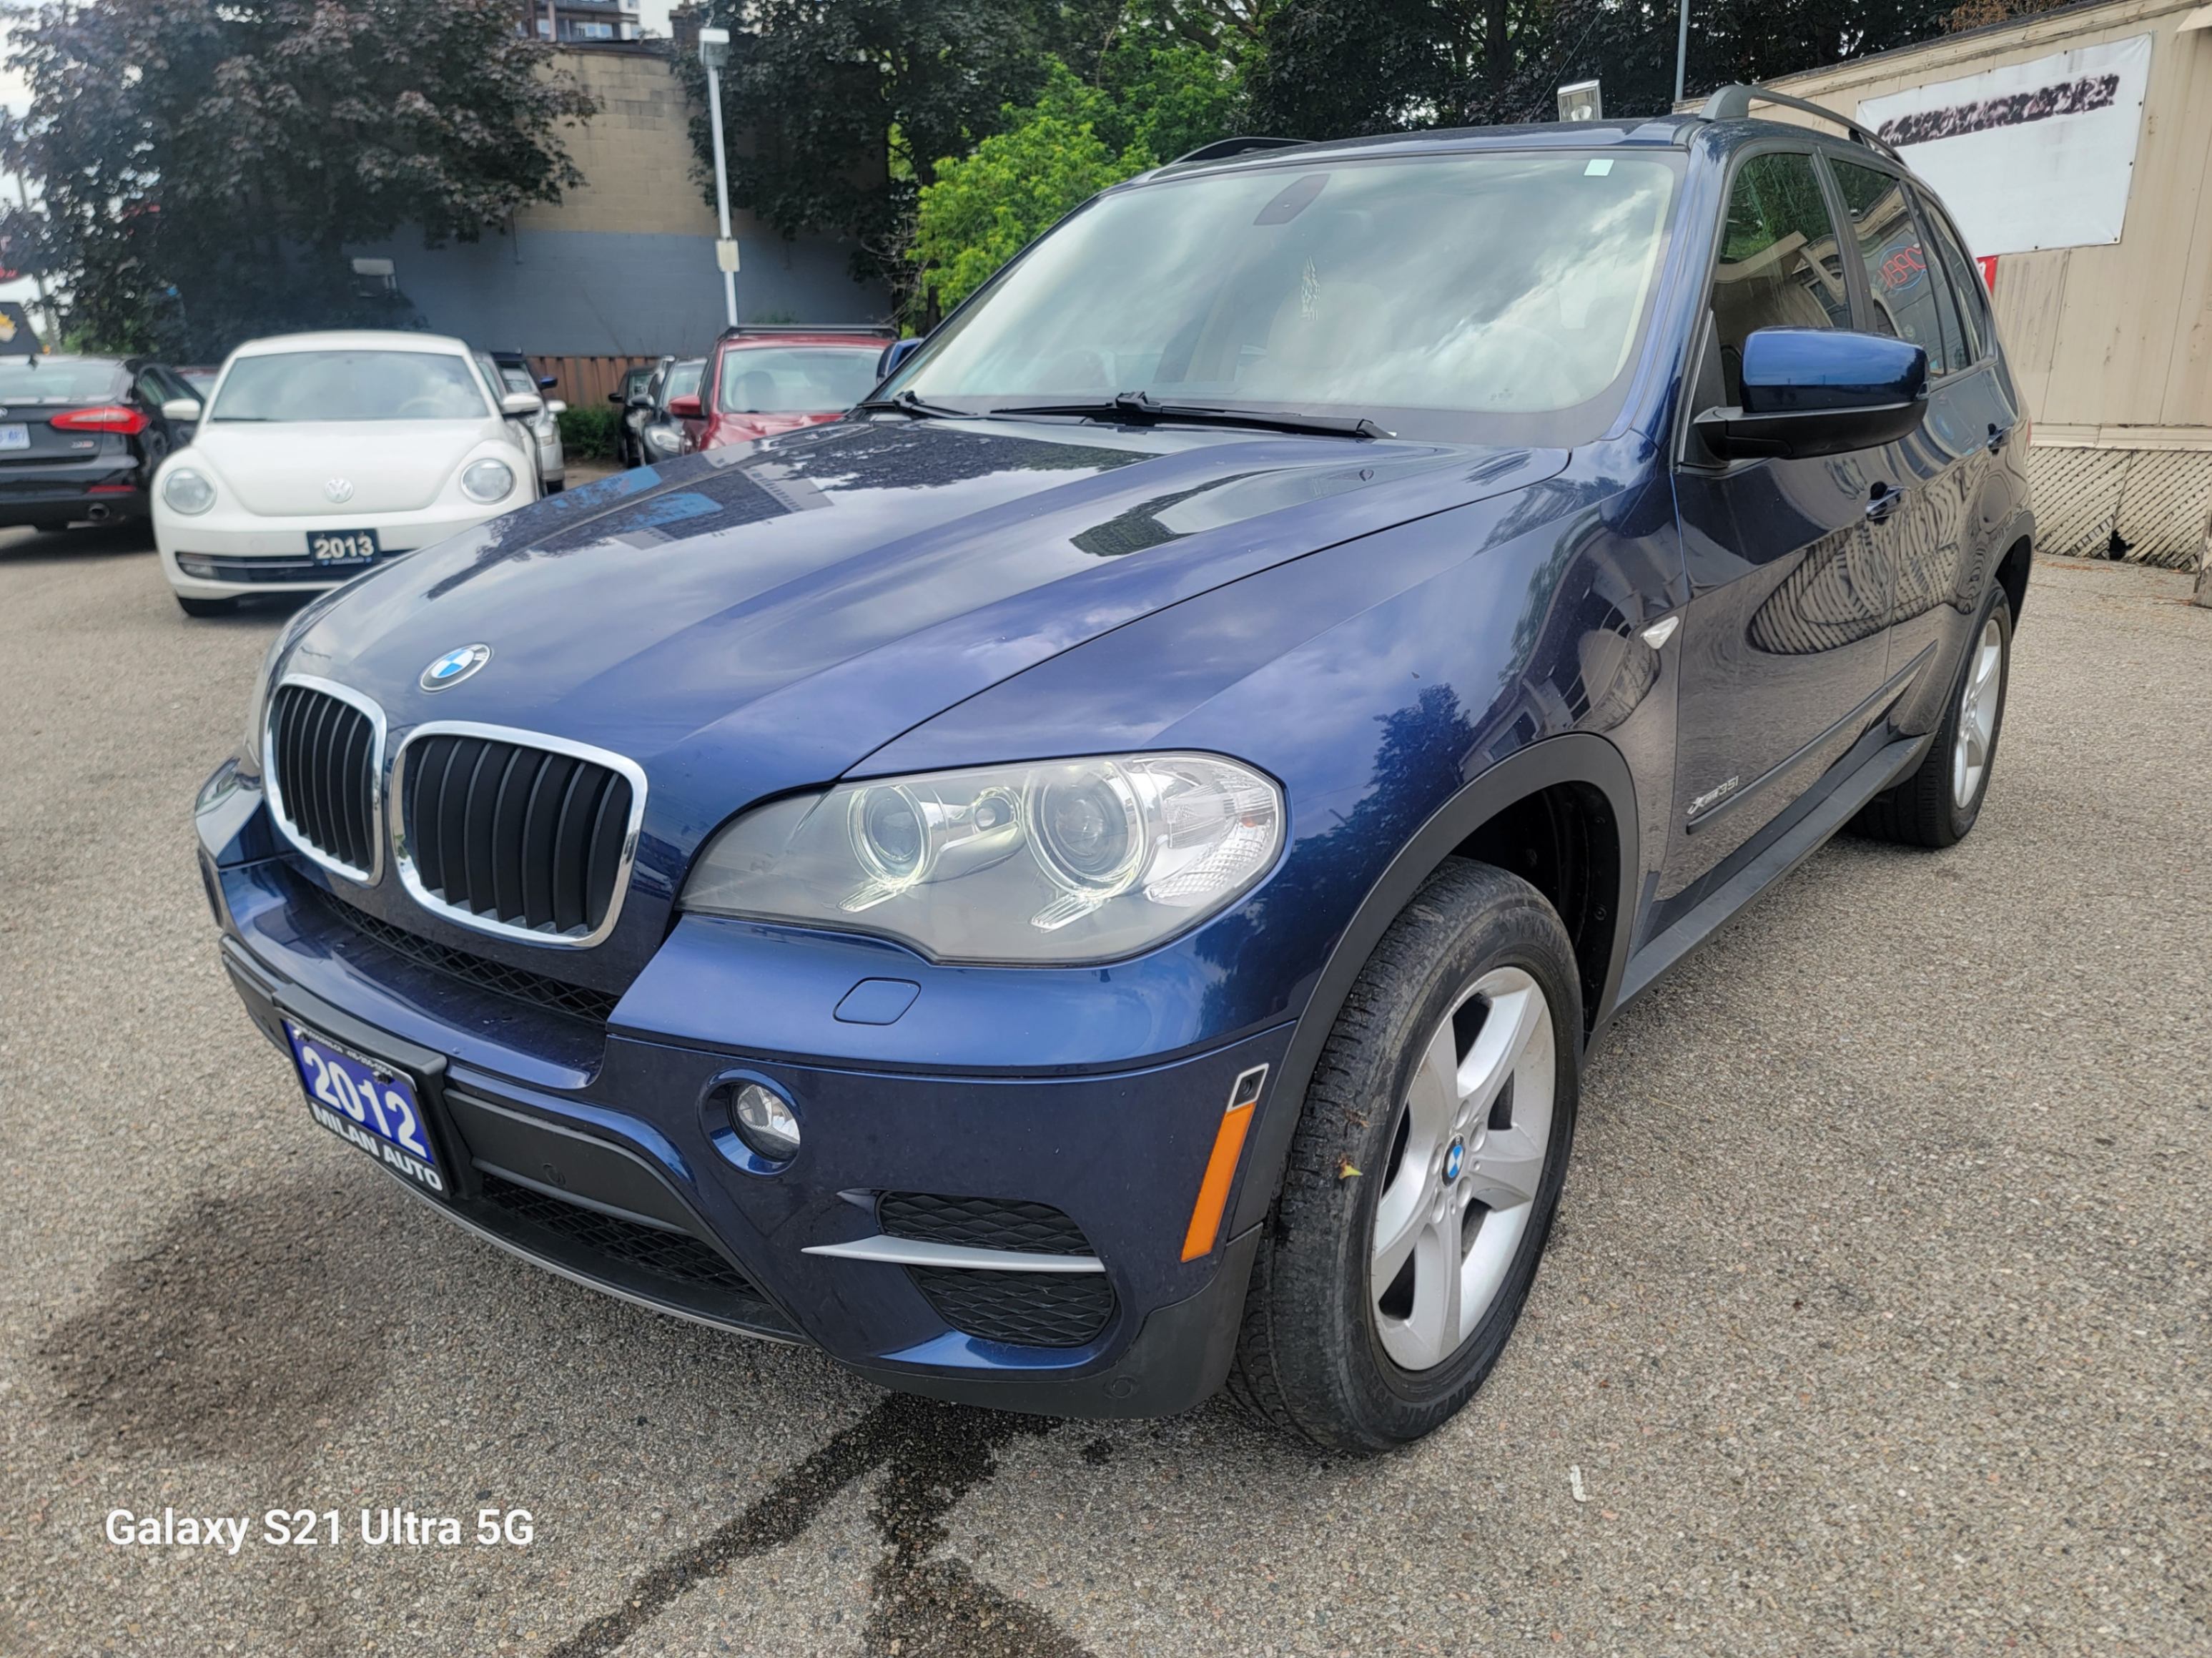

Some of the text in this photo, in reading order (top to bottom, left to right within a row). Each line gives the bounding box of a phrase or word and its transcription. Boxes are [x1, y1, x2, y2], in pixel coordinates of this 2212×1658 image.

[314, 536, 374, 560] 2013
[302, 1045, 428, 1159] 2012
[310, 1102, 443, 1192] MILAN AUTO
